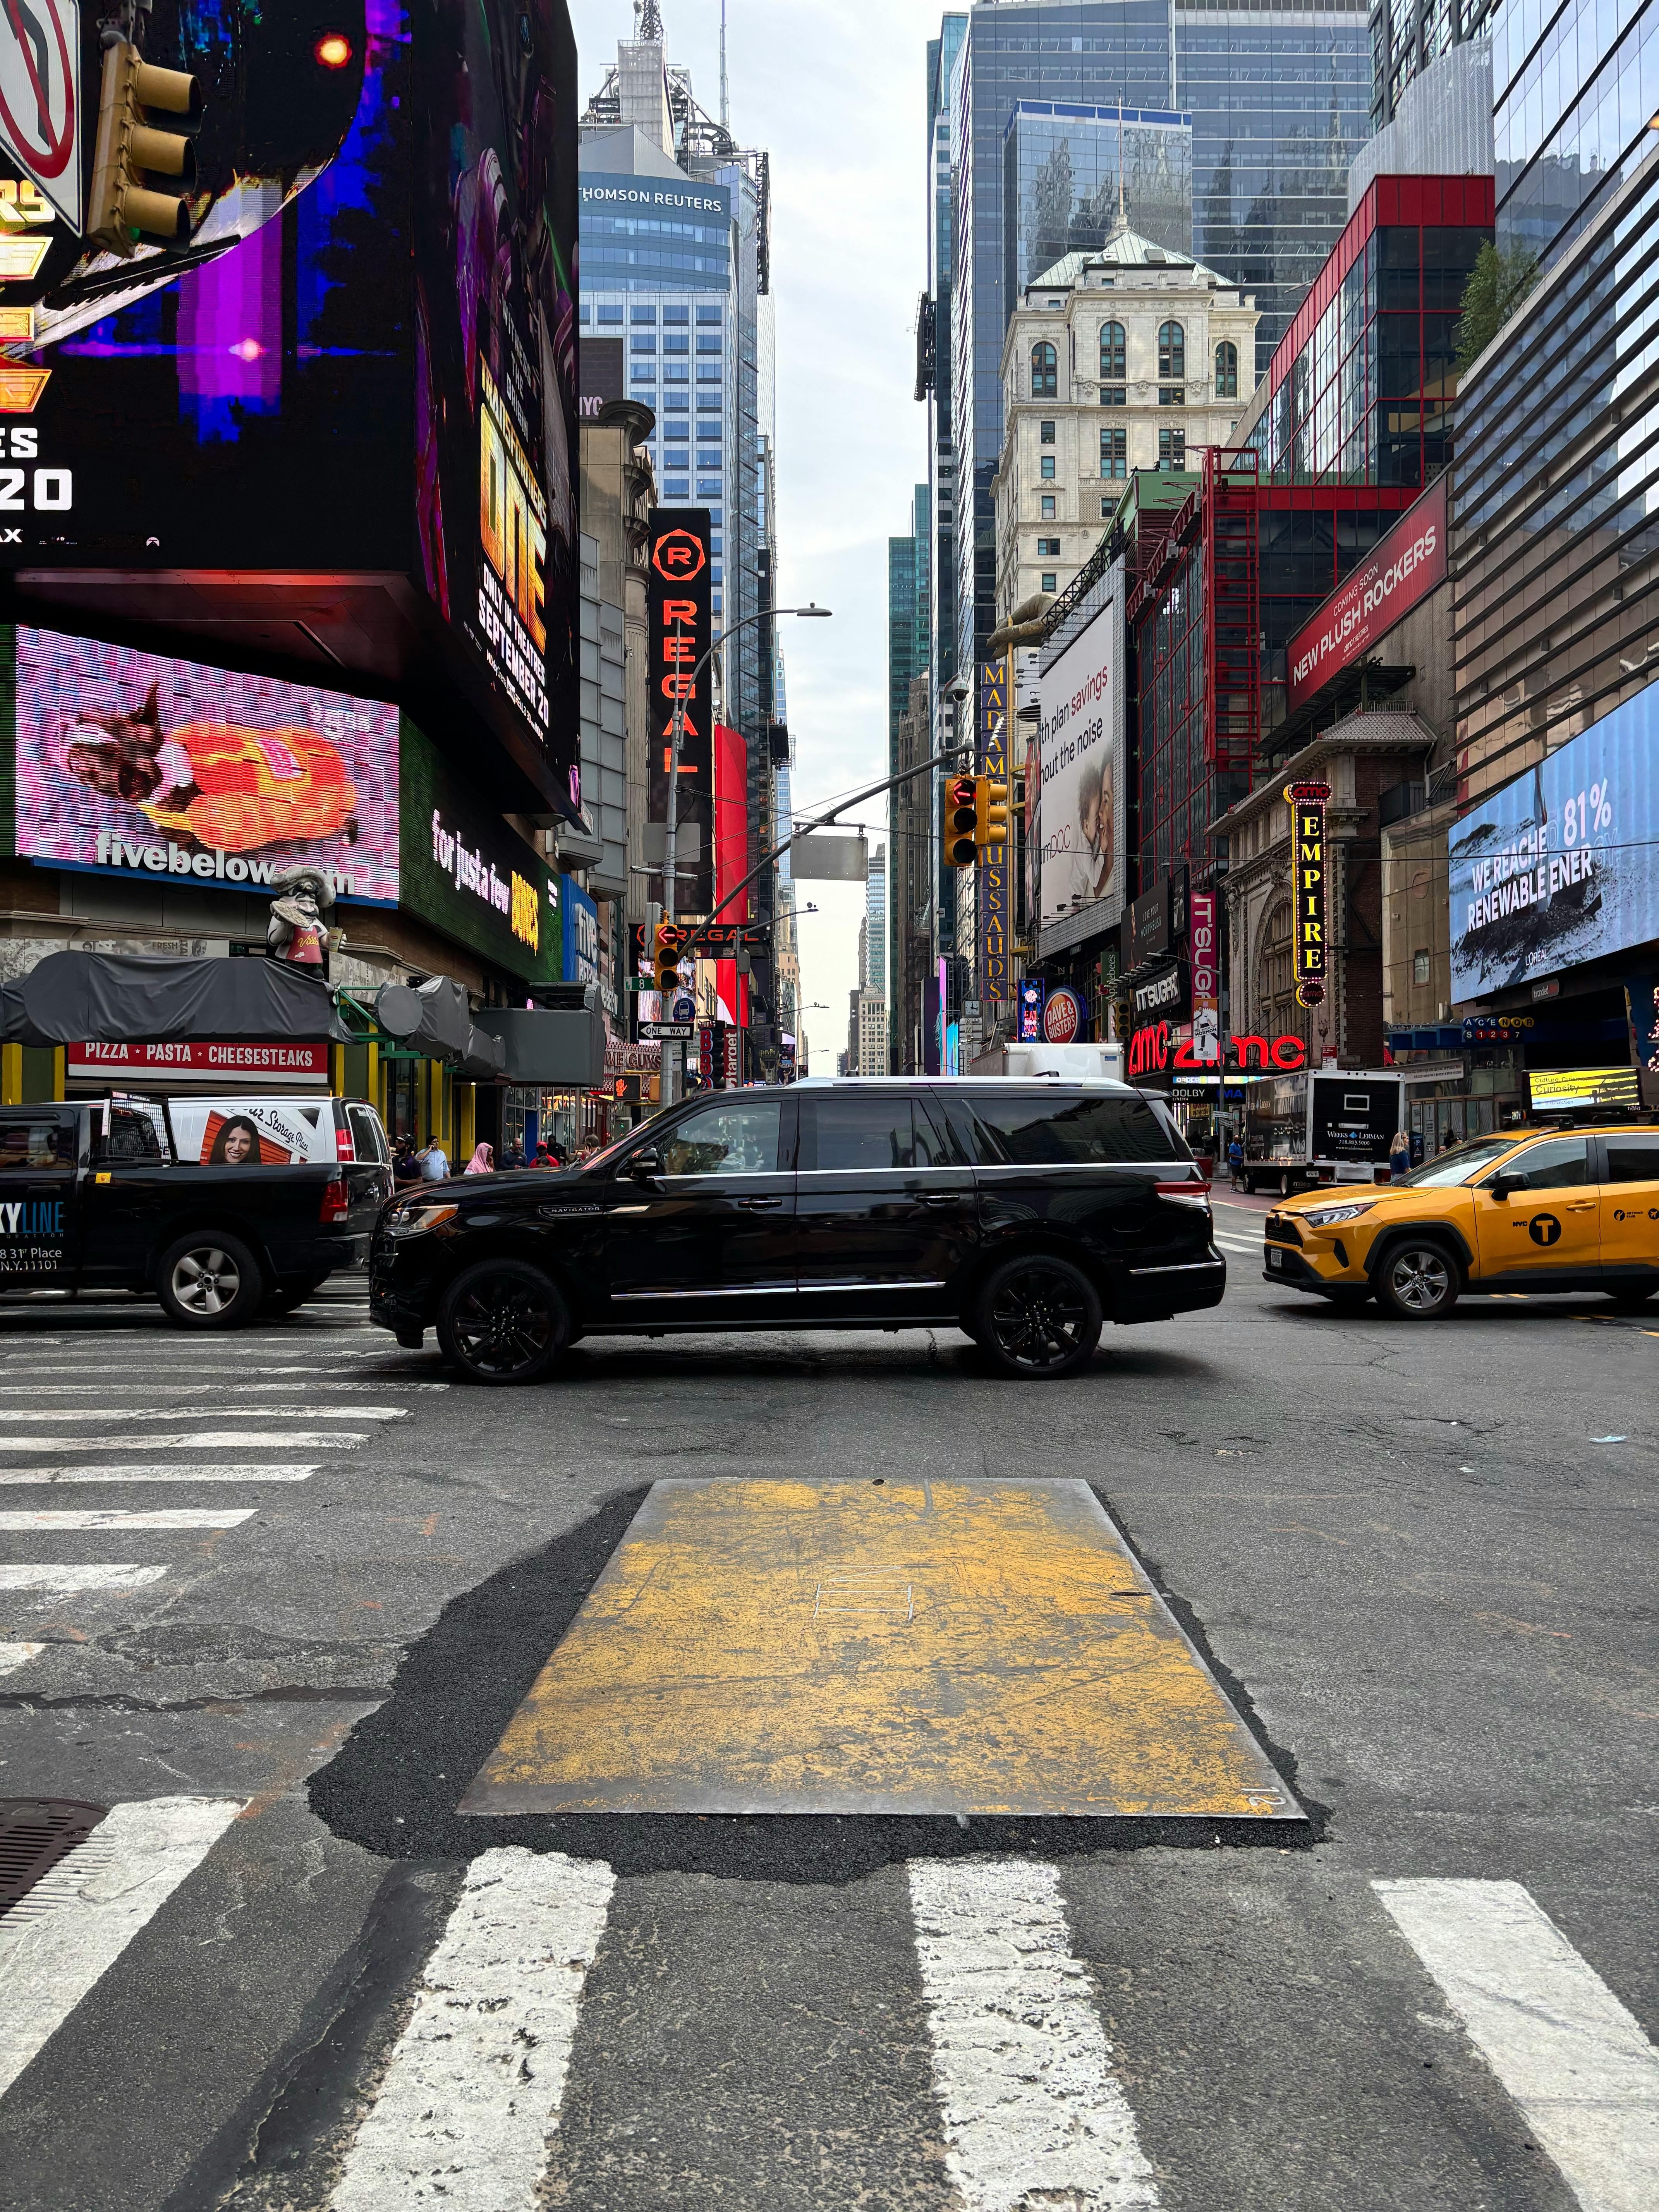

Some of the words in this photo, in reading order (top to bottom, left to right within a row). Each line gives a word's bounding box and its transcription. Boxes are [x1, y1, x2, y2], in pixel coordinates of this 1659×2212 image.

[579, 187, 650, 203] HOMSON
[655, 192, 722, 212] REUTERS
[507, 372, 528, 443] ORIGIN
[0, 529, 22, 543] X
[1293, 643, 1319, 686] NEW
[1321, 605, 1362, 659] PLUSH
[1364, 526, 1436, 618] ROCKERS
[1333, 585, 1358, 617] COMING
[1359, 562, 1379, 591] SOON
[483, 563, 503, 615] ONLY
[504, 599, 512, 632] IN
[514, 617, 545, 687] THEATRES
[479, 589, 536, 709] SEPTEMBER
[538, 687, 549, 728] 20
[661, 600, 698, 773] REGAL
[1051, 703, 1069, 743] plan
[1071, 666, 1108, 716] savings
[984, 665, 1005, 783] MADAM
[1060, 741, 1075, 770] the
[1077, 717, 1103, 753] noise
[1472, 864, 1491, 895] WE
[1564, 777, 1611, 847] 81%
[94, 831, 355, 895] fivebelowm
[1301, 817, 1321, 969] EMPIRE
[1468, 866, 1546, 933] RENEWABLE
[578, 903, 597, 963] five
[985, 845, 1005, 1000] USSAUD'S
[1194, 898, 1212, 998] IT'SUGA
[639, 979, 645, 989] 8
[1135, 972, 1178, 1012] IT'SUGAR
[1047, 1004, 1066, 1025] DAVE
[1068, 1001, 1074, 1015] &
[1048, 1015, 1075, 1039] BUSTER'S
[1195, 1027, 1217, 1037] MORMON
[1513, 1018, 1521, 1027] Q
[85, 1042, 129, 1059] PIZZA
[146, 1044, 192, 1062] PASTA
[208, 1046, 313, 1066] CHEESESTEAKS
[628, 1053, 661, 1068] GUYS
[1217, 1089, 1247, 1098] IMA
[1536, 1084, 1579, 1094] Curiosity
[265, 1110, 294, 1143] Storage
[31, 1247, 62, 1258] Place
[1535, 1220, 1553, 1242] T
